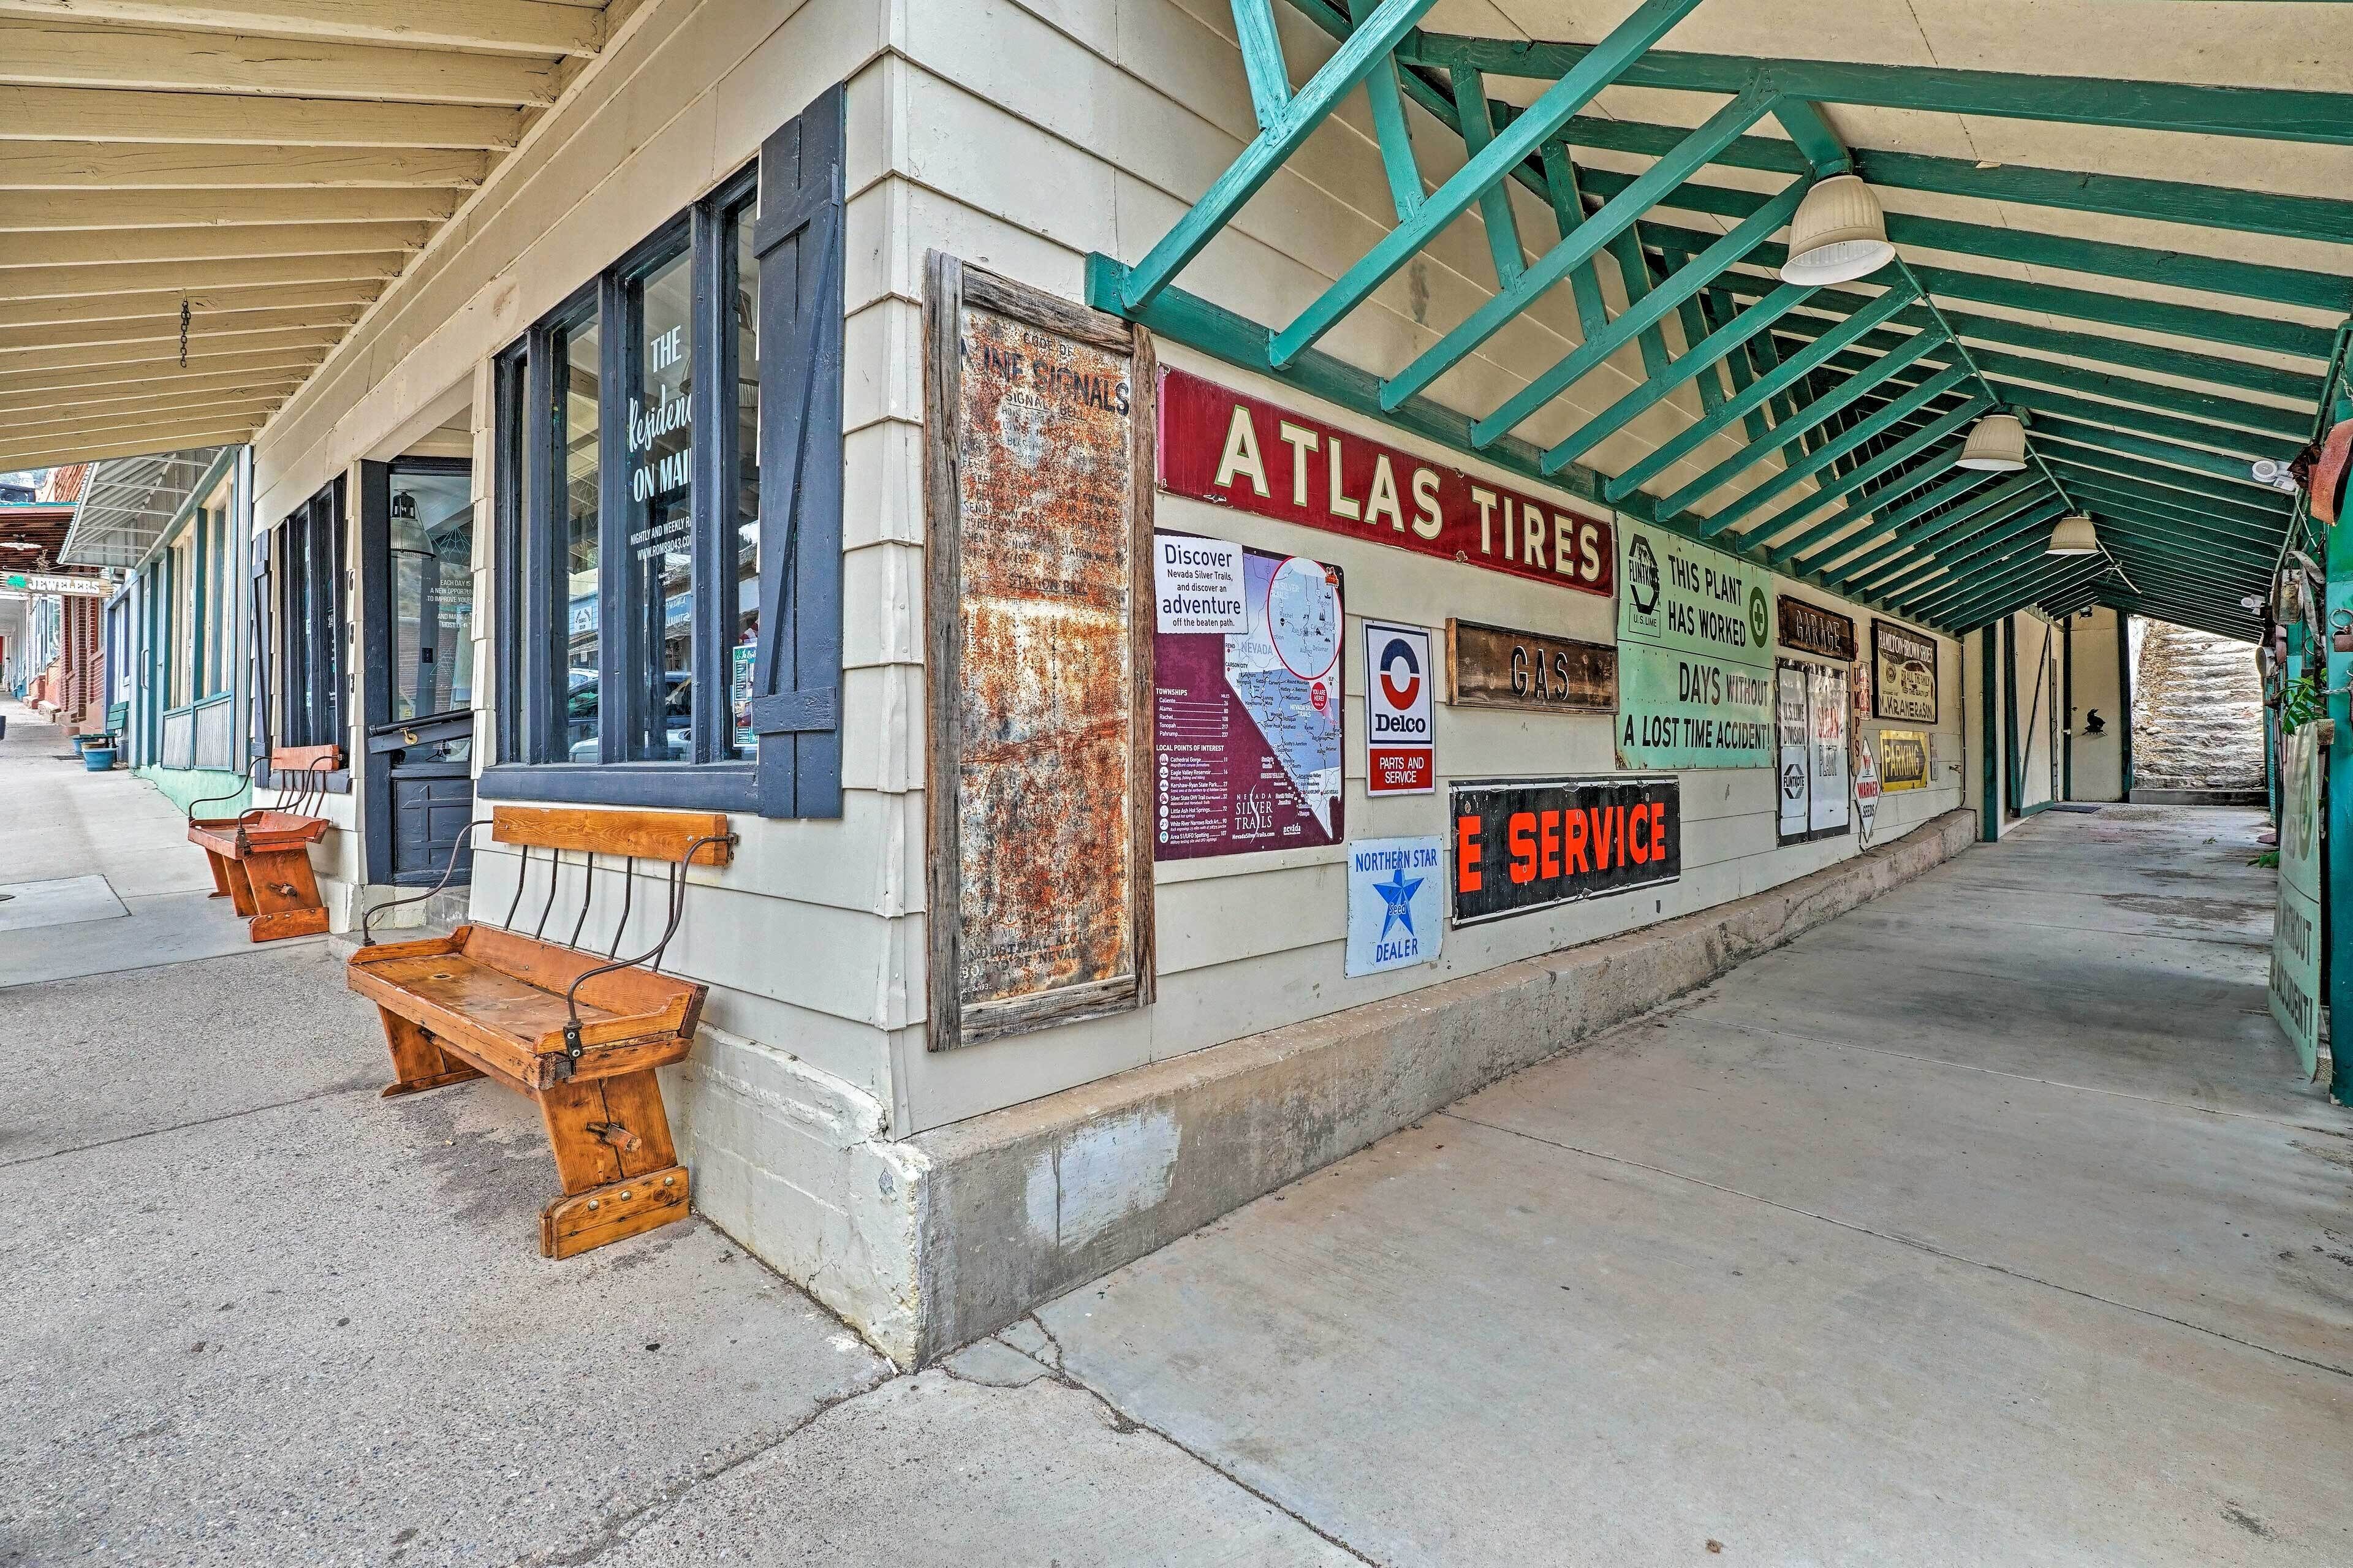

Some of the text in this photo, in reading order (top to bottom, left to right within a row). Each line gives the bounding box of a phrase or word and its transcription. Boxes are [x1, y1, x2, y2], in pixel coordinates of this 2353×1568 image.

[650, 324, 681, 373] THE
[1033, 359, 1129, 417] SIGNALS
[1006, 393, 1048, 411] SIGNAL
[634, 463, 654, 502] ON
[1214, 404, 1601, 582] ATLAS TIRES
[963, 501, 988, 514] SEND
[631, 529, 650, 545] NIGHTLY
[651, 525, 662, 539] AND
[664, 518, 684, 535] WEEKLY
[1061, 545, 1091, 560] STATION
[1165, 544, 1232, 567] Discover
[1010, 574, 1058, 590] STATION
[1167, 570, 1233, 581] Nevada Silver Trails,
[1668, 555, 1742, 607] THIS PLANT
[28, 577, 100, 594] JEWELERS
[1163, 594, 1241, 615] adventure
[1173, 617, 1235, 629] off the beaten path.
[1645, 616, 1656, 627] LIME
[1668, 600, 1746, 648] HAS WORKED
[1796, 610, 1841, 651] GARAGE
[1241, 642, 1273, 656] NEVADA
[1511, 645, 1569, 700] GAS
[1680, 662, 1768, 706] DAYS WITHOUT
[1375, 713, 1426, 733] Delco
[1794, 705, 1804, 722] LIME
[1818, 706, 1839, 738] SLOAN
[1624, 714, 1770, 751] A LOST TIME ACCIDENT!
[1784, 726, 1805, 745] DIVISION
[1380, 757, 1424, 770] PARTS AND
[1884, 744, 1920, 776] PARKING
[1385, 771, 1417, 784] SERVICE
[1783, 776, 1805, 787] FLINTKOTE
[1857, 781, 1878, 799] WARNER
[1235, 801, 1273, 815] SILVER
[1863, 804, 1874, 818] SEEDS
[1235, 816, 1272, 830] TRAILS
[1283, 822, 1301, 833] nevada
[1458, 803, 1665, 893] E SERVICE
[1355, 848, 1437, 873] NORTHERN STAR
[1389, 900, 1407, 916] Seed
[1376, 939, 1419, 963] DEALER
